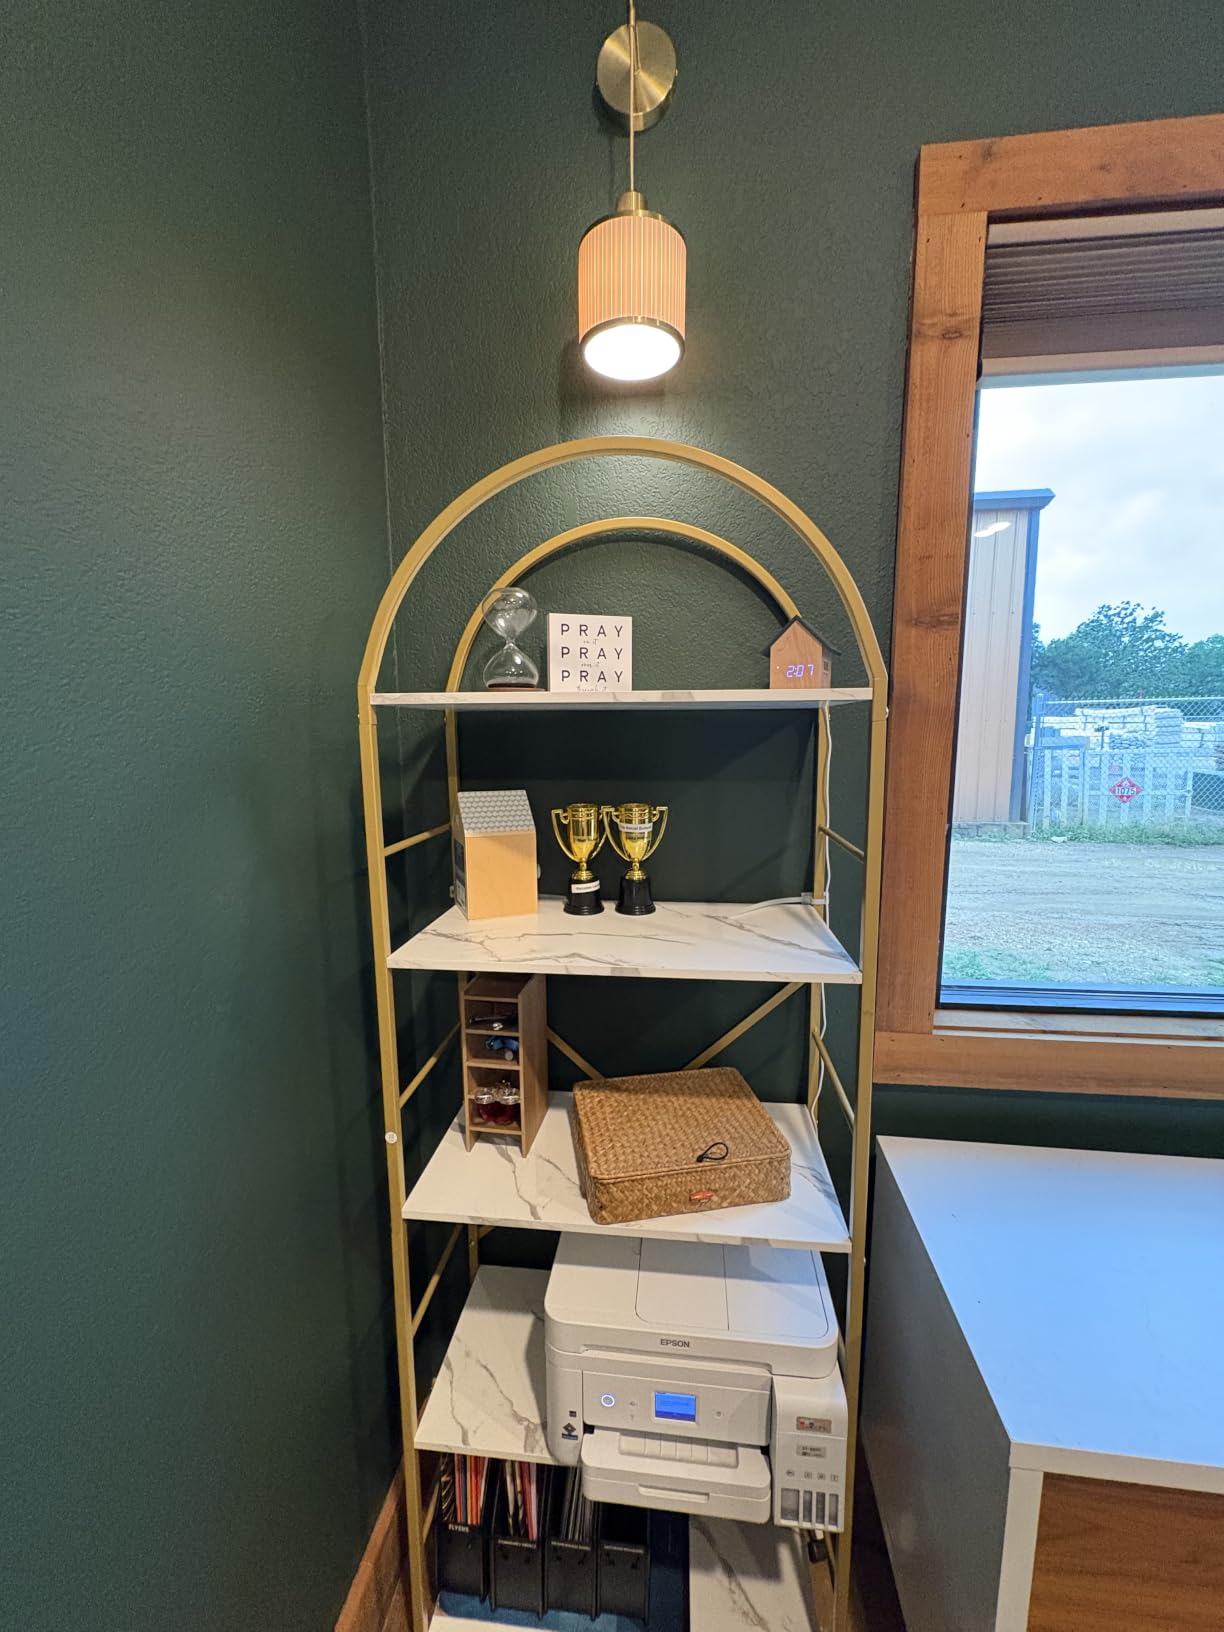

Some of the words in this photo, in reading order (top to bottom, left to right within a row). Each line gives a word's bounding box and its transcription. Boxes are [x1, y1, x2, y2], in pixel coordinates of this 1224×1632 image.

[560, 623, 623, 638] PRAY
[560, 646, 623, 660] PRAY
[561, 669, 623, 683] PRAY
[786, 664, 814, 678] 2:07
[1116, 787, 1136, 795] 1075
[660, 1338, 690, 1348] EPSON
